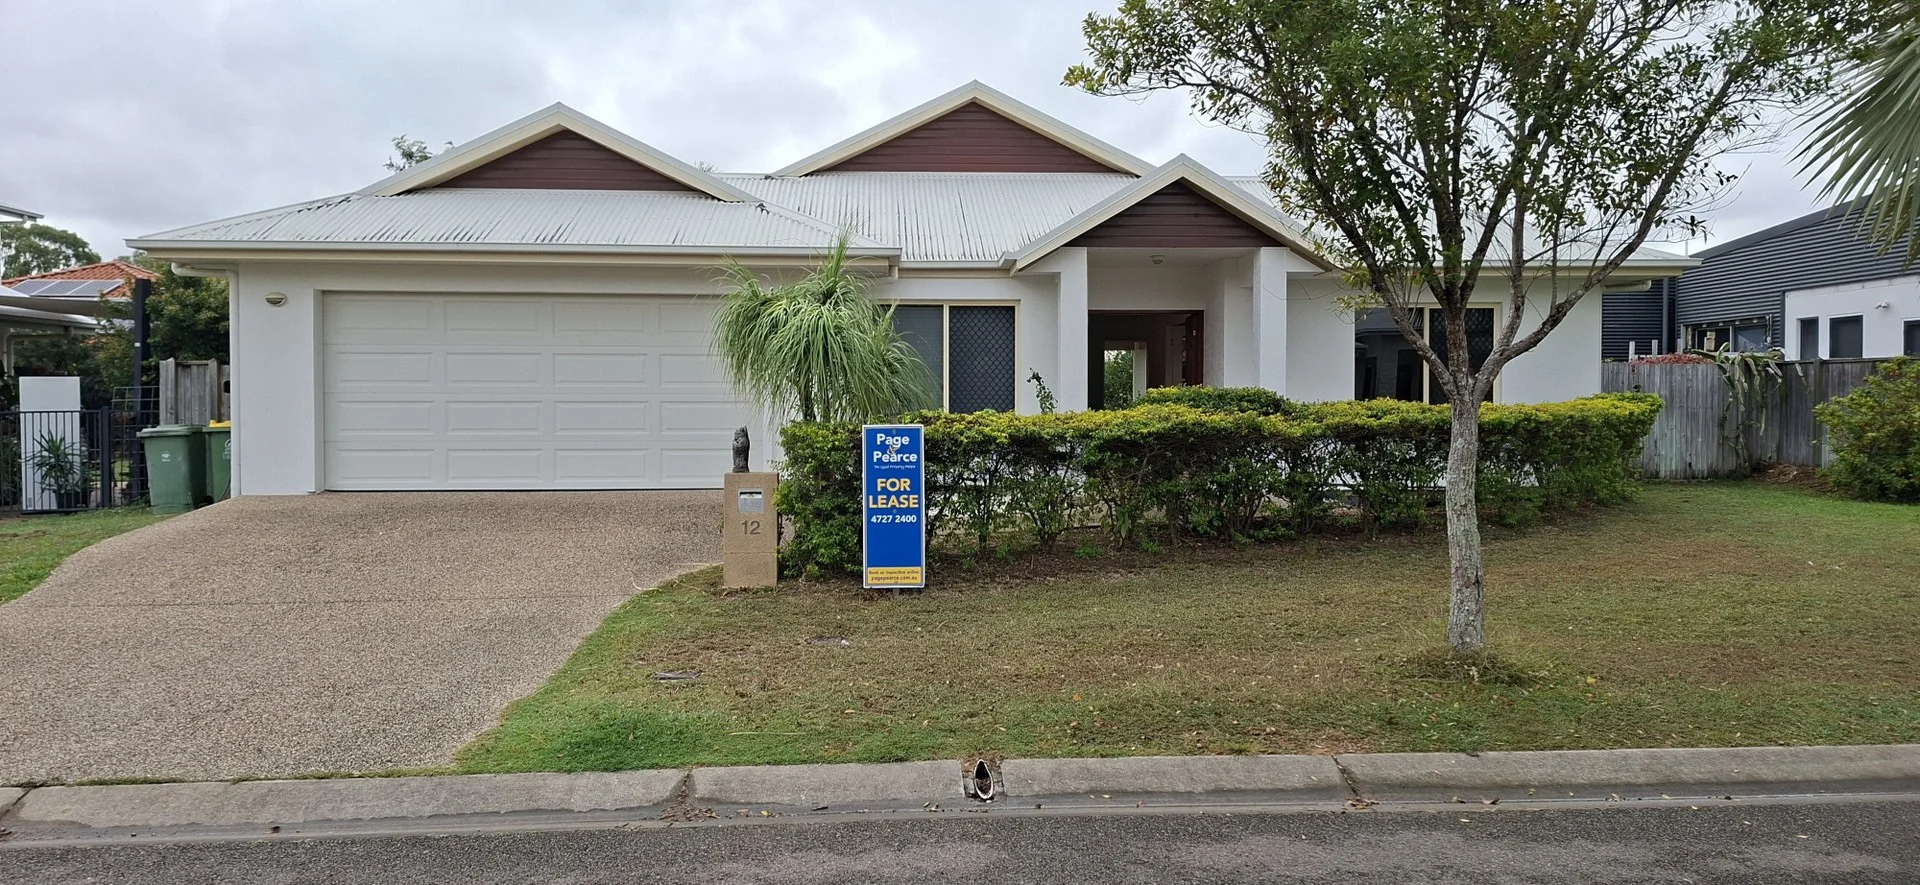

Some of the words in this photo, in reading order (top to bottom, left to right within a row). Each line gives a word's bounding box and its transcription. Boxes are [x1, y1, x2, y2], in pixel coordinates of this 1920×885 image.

[876, 433, 910, 448] Page
[873, 451, 918, 463] Pearce
[877, 478, 911, 492] FOR
[869, 494, 919, 508] LEASE
[870, 515, 893, 523] 4727
[894, 514, 917, 523] 2400
[741, 520, 761, 535] 12
